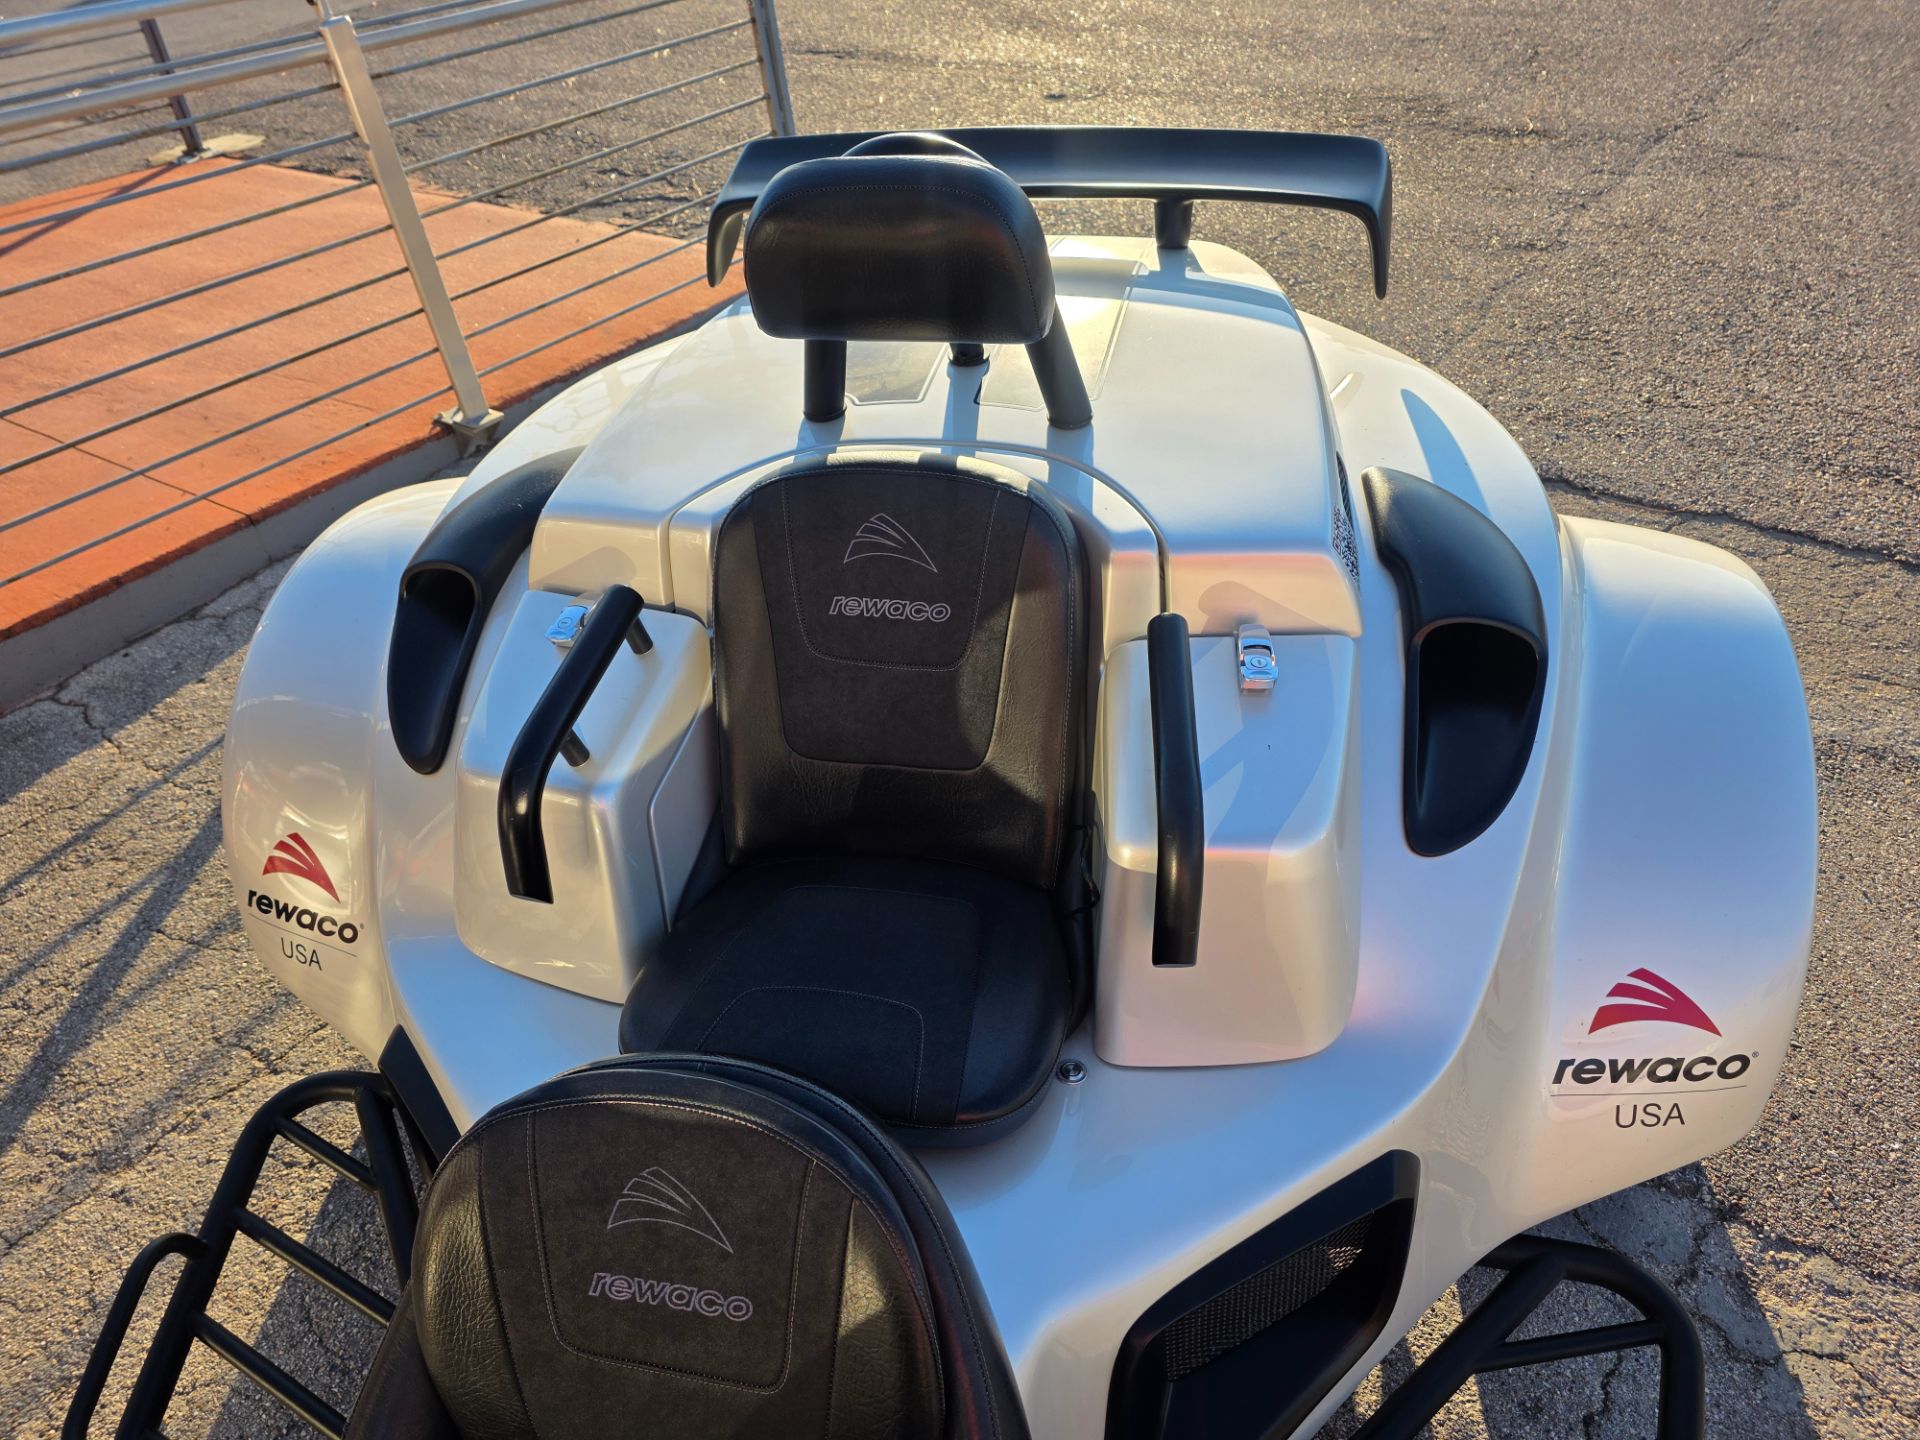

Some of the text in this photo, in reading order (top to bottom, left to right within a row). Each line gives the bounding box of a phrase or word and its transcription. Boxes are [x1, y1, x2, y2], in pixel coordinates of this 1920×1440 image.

[829, 596, 951, 622] rewaco
[247, 889, 359, 944] rewaco
[280, 937, 322, 971] USA
[1552, 1053, 1751, 1085] rewaco
[1615, 1102, 1686, 1129] USA
[588, 1272, 753, 1322] rewaco
